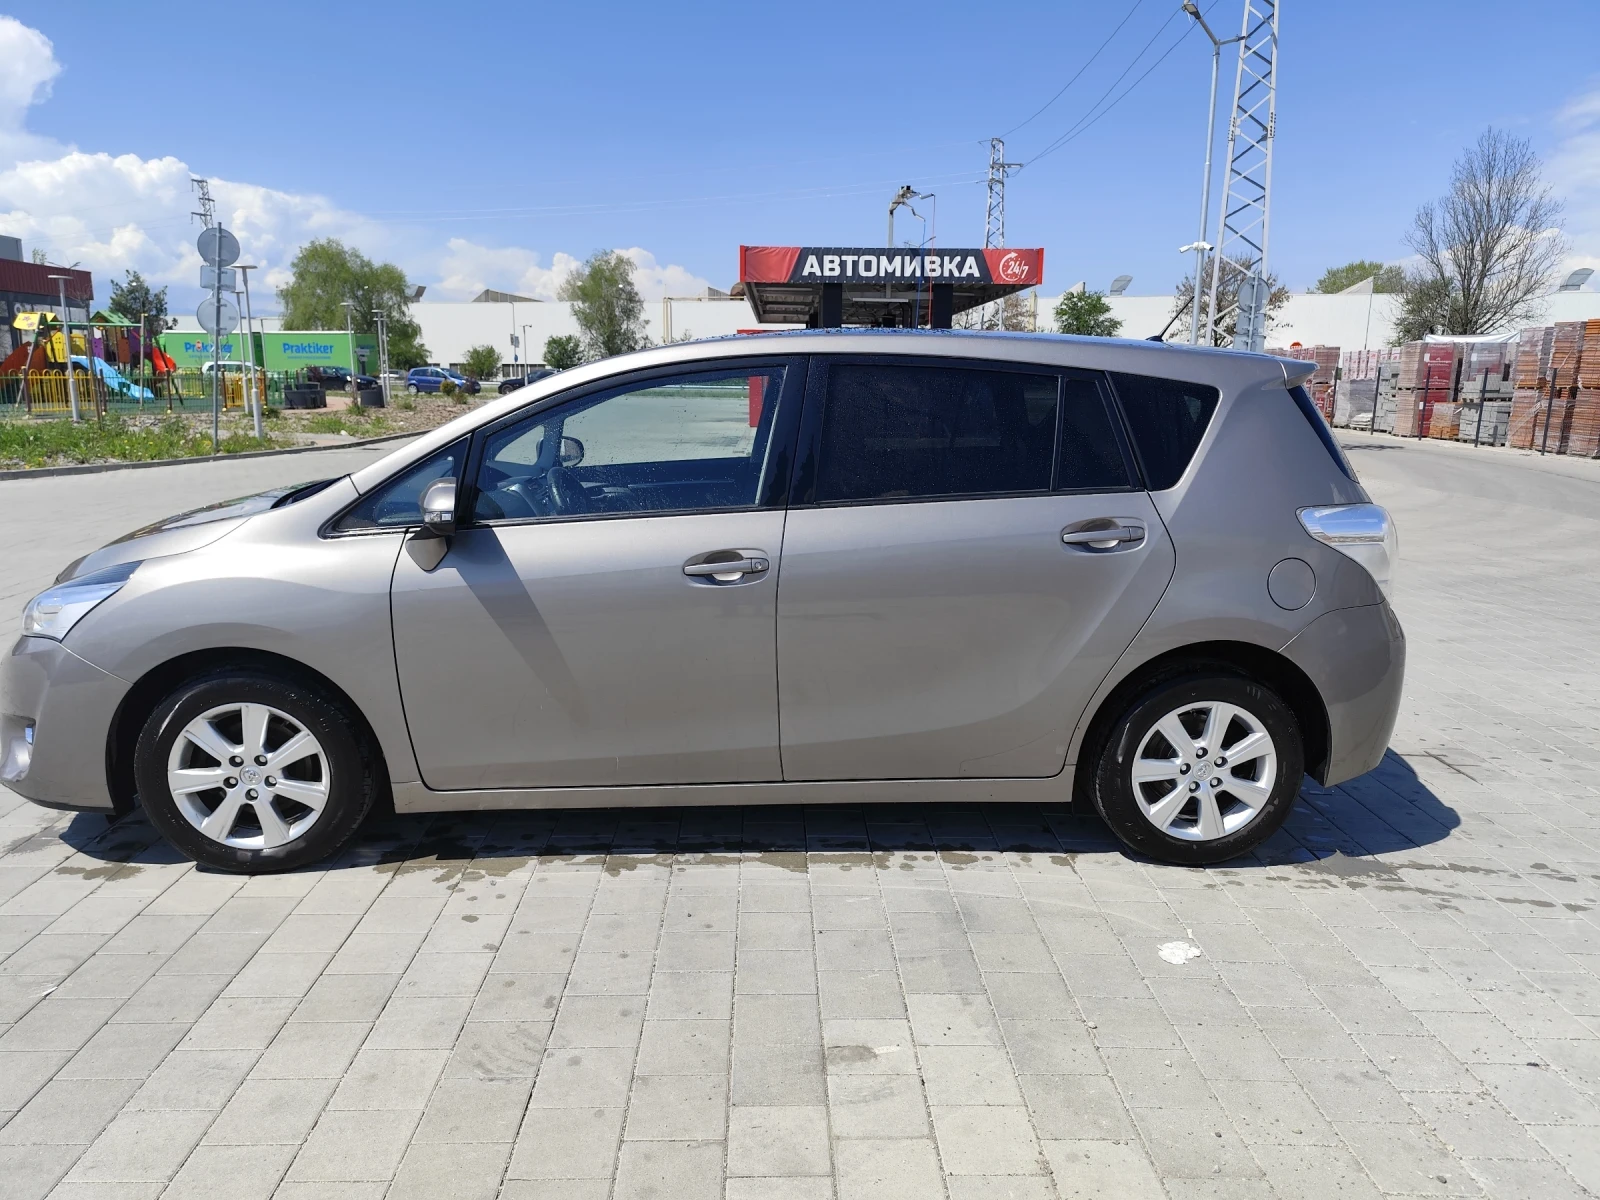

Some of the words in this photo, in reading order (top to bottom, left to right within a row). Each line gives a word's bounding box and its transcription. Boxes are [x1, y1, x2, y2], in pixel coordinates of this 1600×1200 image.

[802, 254, 980, 278] АВТОМИВКА
[1007, 260, 1029, 279] 24/7
[282, 342, 334, 354] Praktiker
